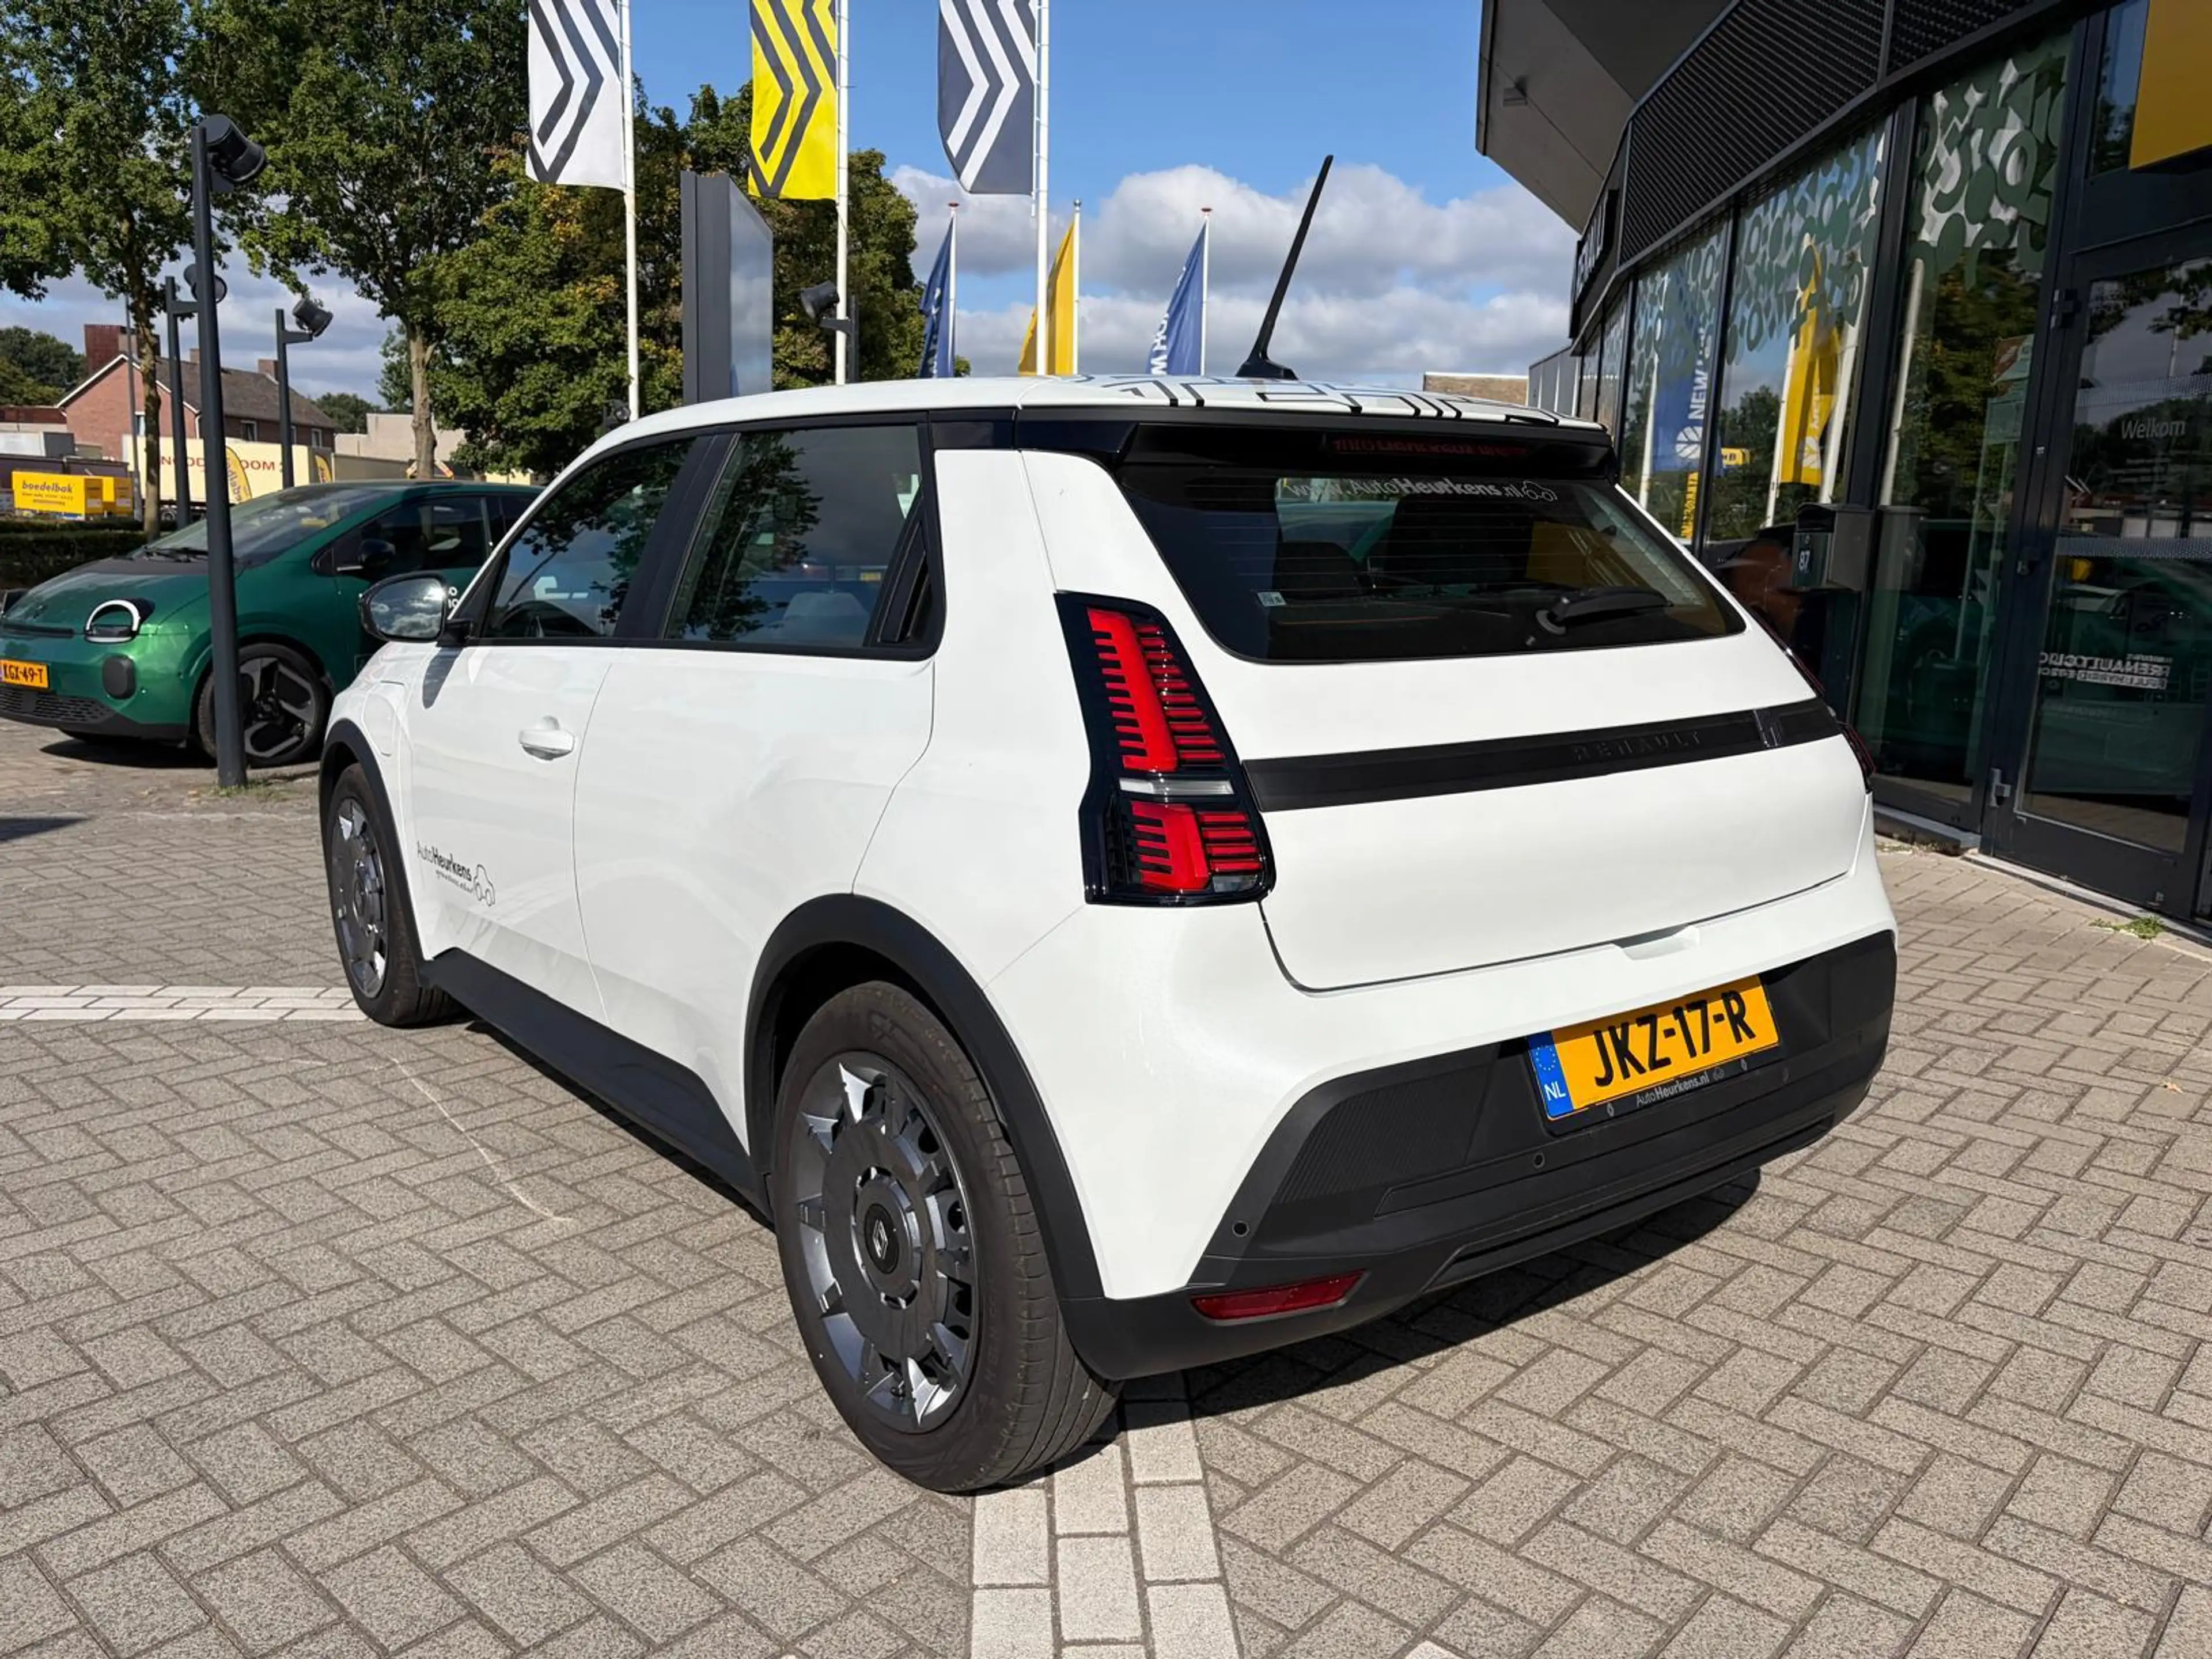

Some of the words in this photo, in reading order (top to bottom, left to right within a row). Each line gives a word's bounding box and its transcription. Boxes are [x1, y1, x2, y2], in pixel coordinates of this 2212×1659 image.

[1688, 368, 1709, 421] NEW
[2122, 418, 2186, 440] Welkom
[22, 480, 72, 494] boedelbak
[1798, 550, 1810, 573] 87
[417, 840, 472, 881] AutoHeurkens
[1593, 990, 1756, 1088] JKZ-17-R
[1544, 1082, 1566, 1101] NL
[1636, 1071, 1710, 1107] AutoHeurkens.nl
